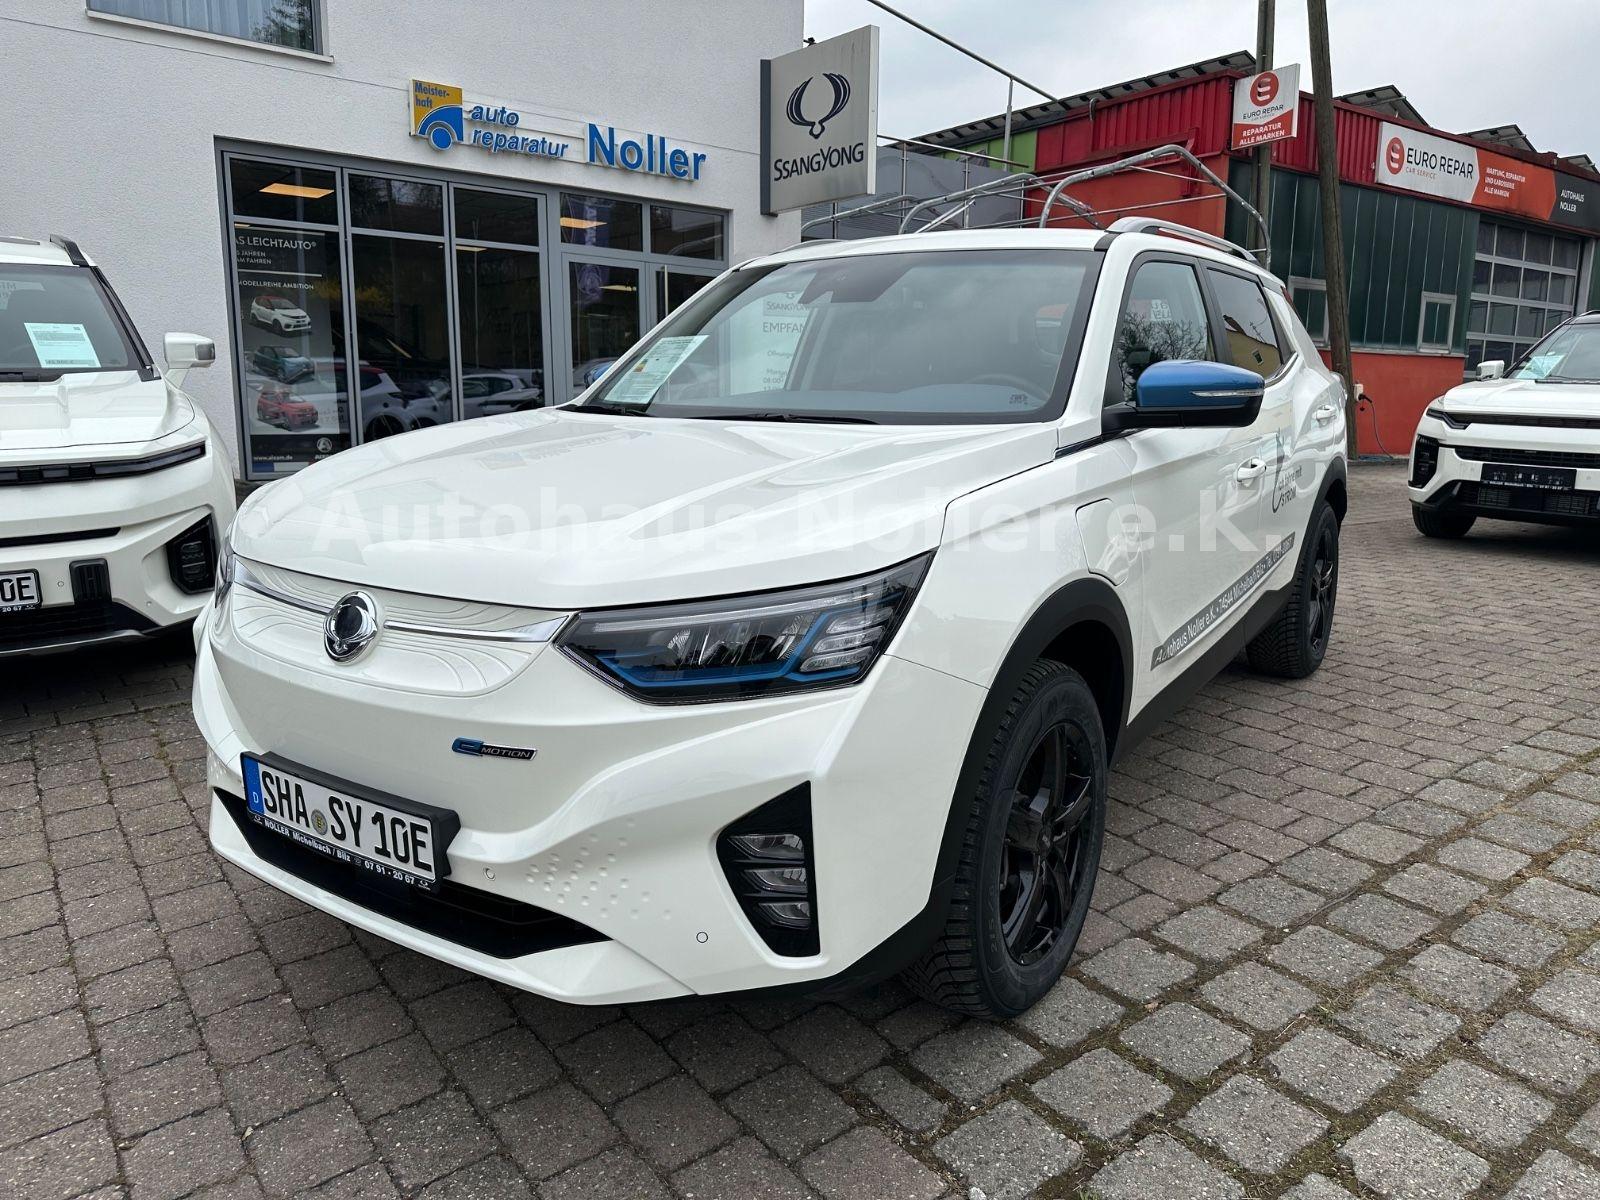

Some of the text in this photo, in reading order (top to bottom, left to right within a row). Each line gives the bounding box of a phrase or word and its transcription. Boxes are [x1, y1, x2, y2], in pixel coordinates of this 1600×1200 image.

[414, 81, 450, 97] Meister-
[415, 95, 433, 109] haft
[471, 105, 520, 126] auto
[1242, 104, 1284, 120] EURO REPAR
[1239, 130, 1285, 145] ALLE MARKEN
[1242, 122, 1282, 137] REPARATUR
[472, 128, 569, 157] reparatur
[588, 123, 707, 180] Noller
[1406, 147, 1474, 180] EURO REPAR
[1560, 189, 1585, 202] AUTOHAUS
[1560, 201, 1577, 212] NOLLER
[253, 791, 259, 804] D
[261, 770, 433, 873] SHA SY 10E
[264, 820, 290, 837] NOLLER
[292, 828, 332, 856] Michelbach
[336, 849, 351, 862] Bilz
[364, 861, 375, 871] 07
[375, 863, 386, 875] 91
[392, 868, 403, 881] 20
[404, 873, 415, 885] 67
